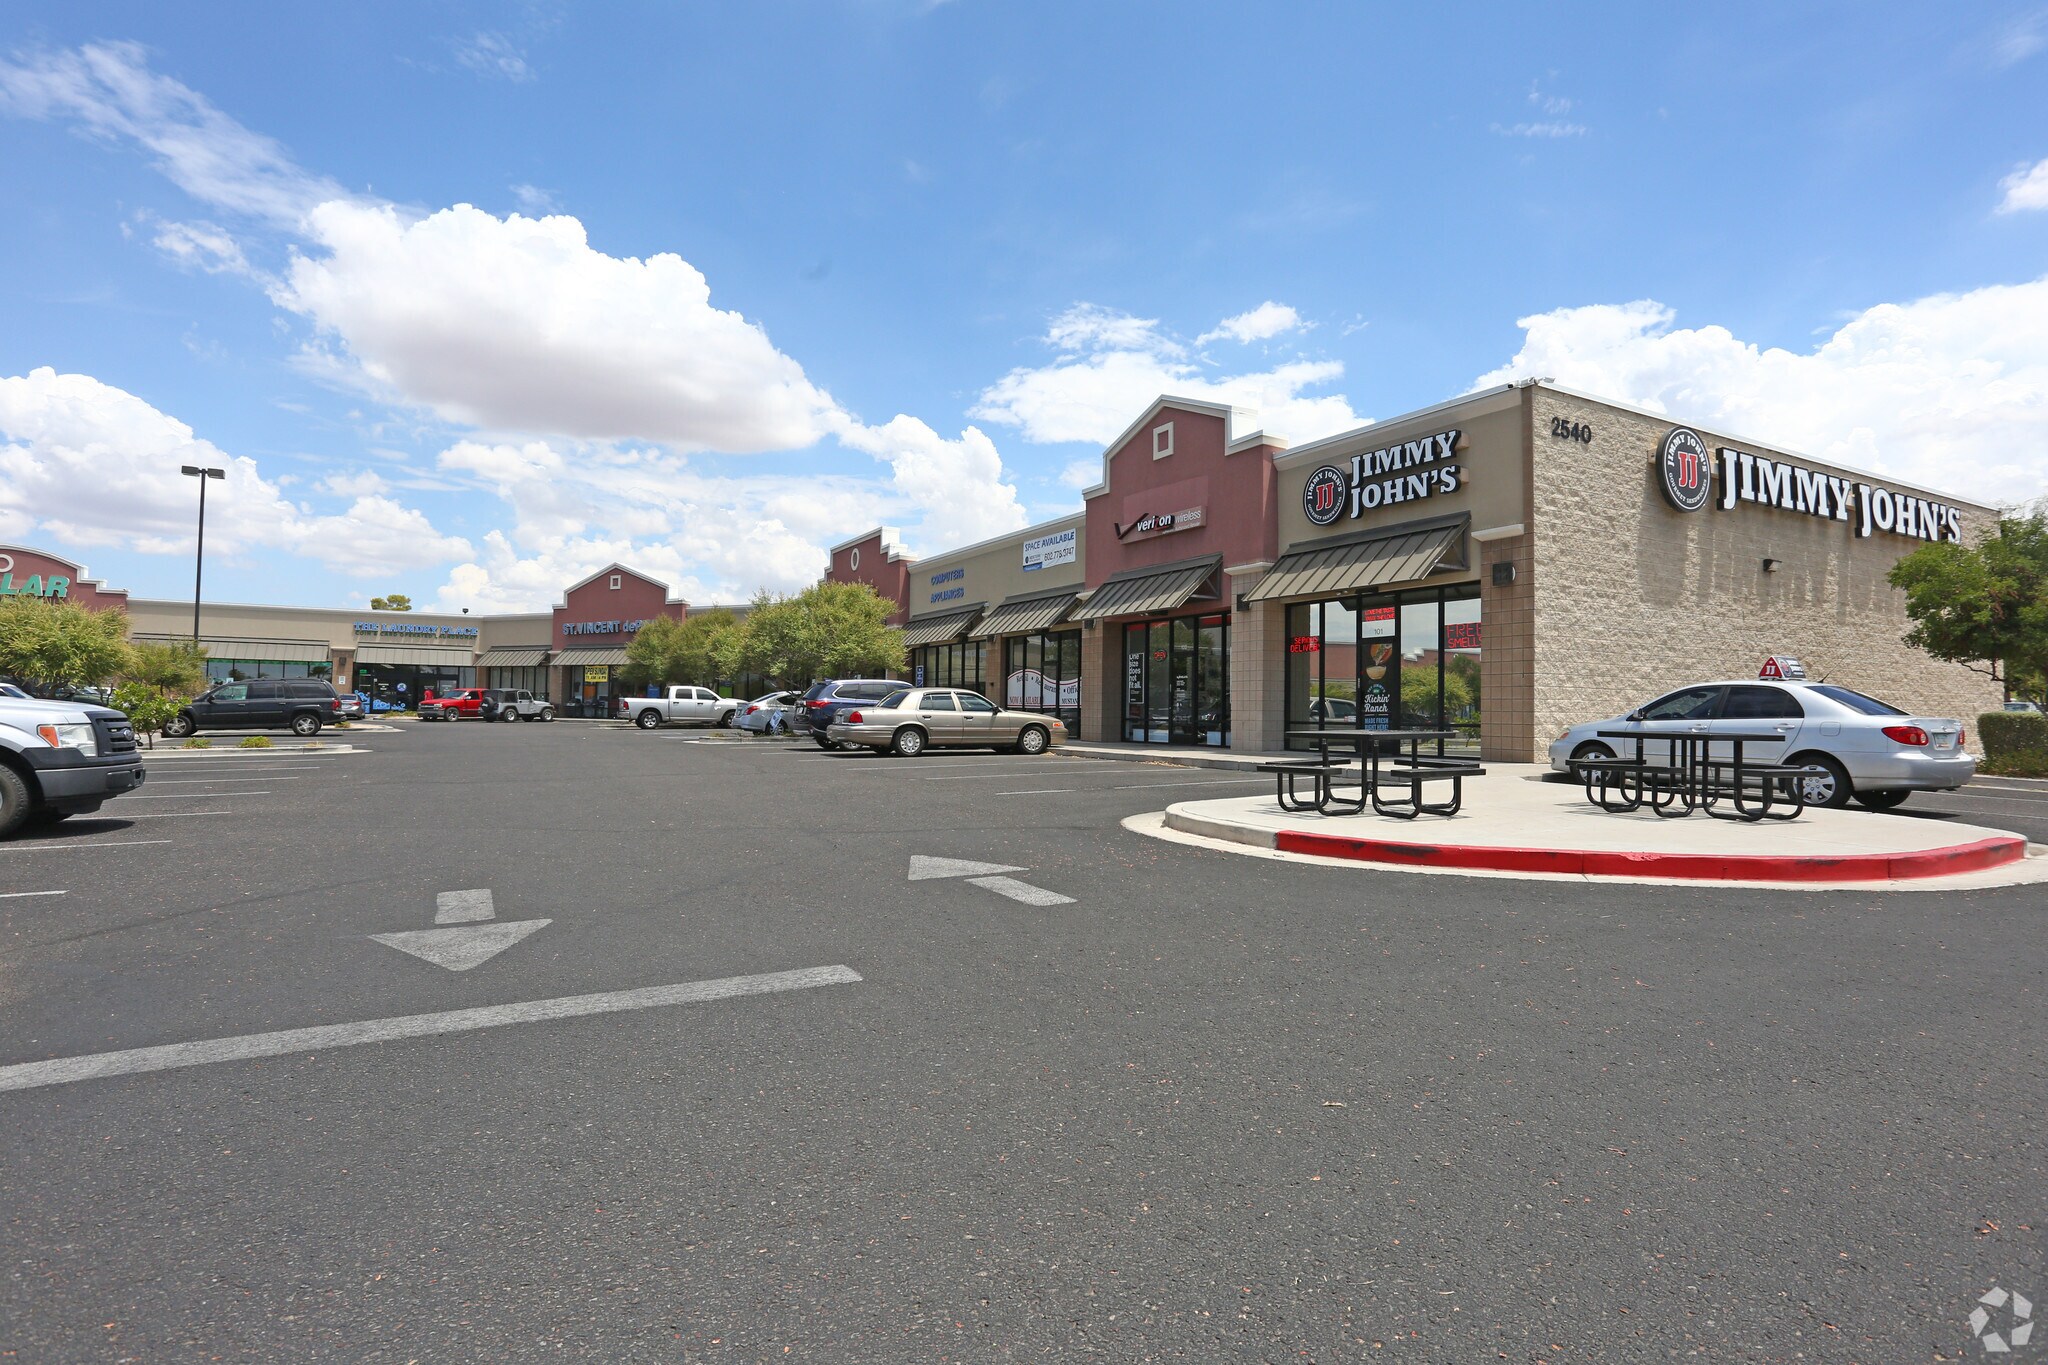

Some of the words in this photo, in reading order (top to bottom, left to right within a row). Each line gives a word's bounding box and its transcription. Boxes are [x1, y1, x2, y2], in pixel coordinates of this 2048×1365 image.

[1551, 416, 1592, 443] 2540
[1351, 431, 1458, 487] JIMMY
[1668, 434, 1685, 467] JIMMY
[1687, 435, 1708, 472] JOHN'S
[1677, 450, 1699, 490] JJ
[1307, 472, 1323, 500] JIMMY
[1324, 471, 1343, 492] JOHN'S
[1316, 482, 1334, 511] JJ
[1350, 465, 1458, 519] JOHN'S
[1719, 447, 1851, 521] JIMMY
[1855, 483, 1961, 544] JOHN'S
[1136, 514, 1174, 532] verizon
[1174, 510, 1202, 524] wireless
[1025, 541, 1041, 551] SPACE
[1041, 532, 1075, 548] AVAILABLE
[353, 621, 379, 632] THE
[380, 623, 438, 634] LAUNDRY
[439, 626, 479, 636] PLACE
[1364, 693, 1391, 703] Kickin'
[1364, 703, 1388, 713] Ranch
